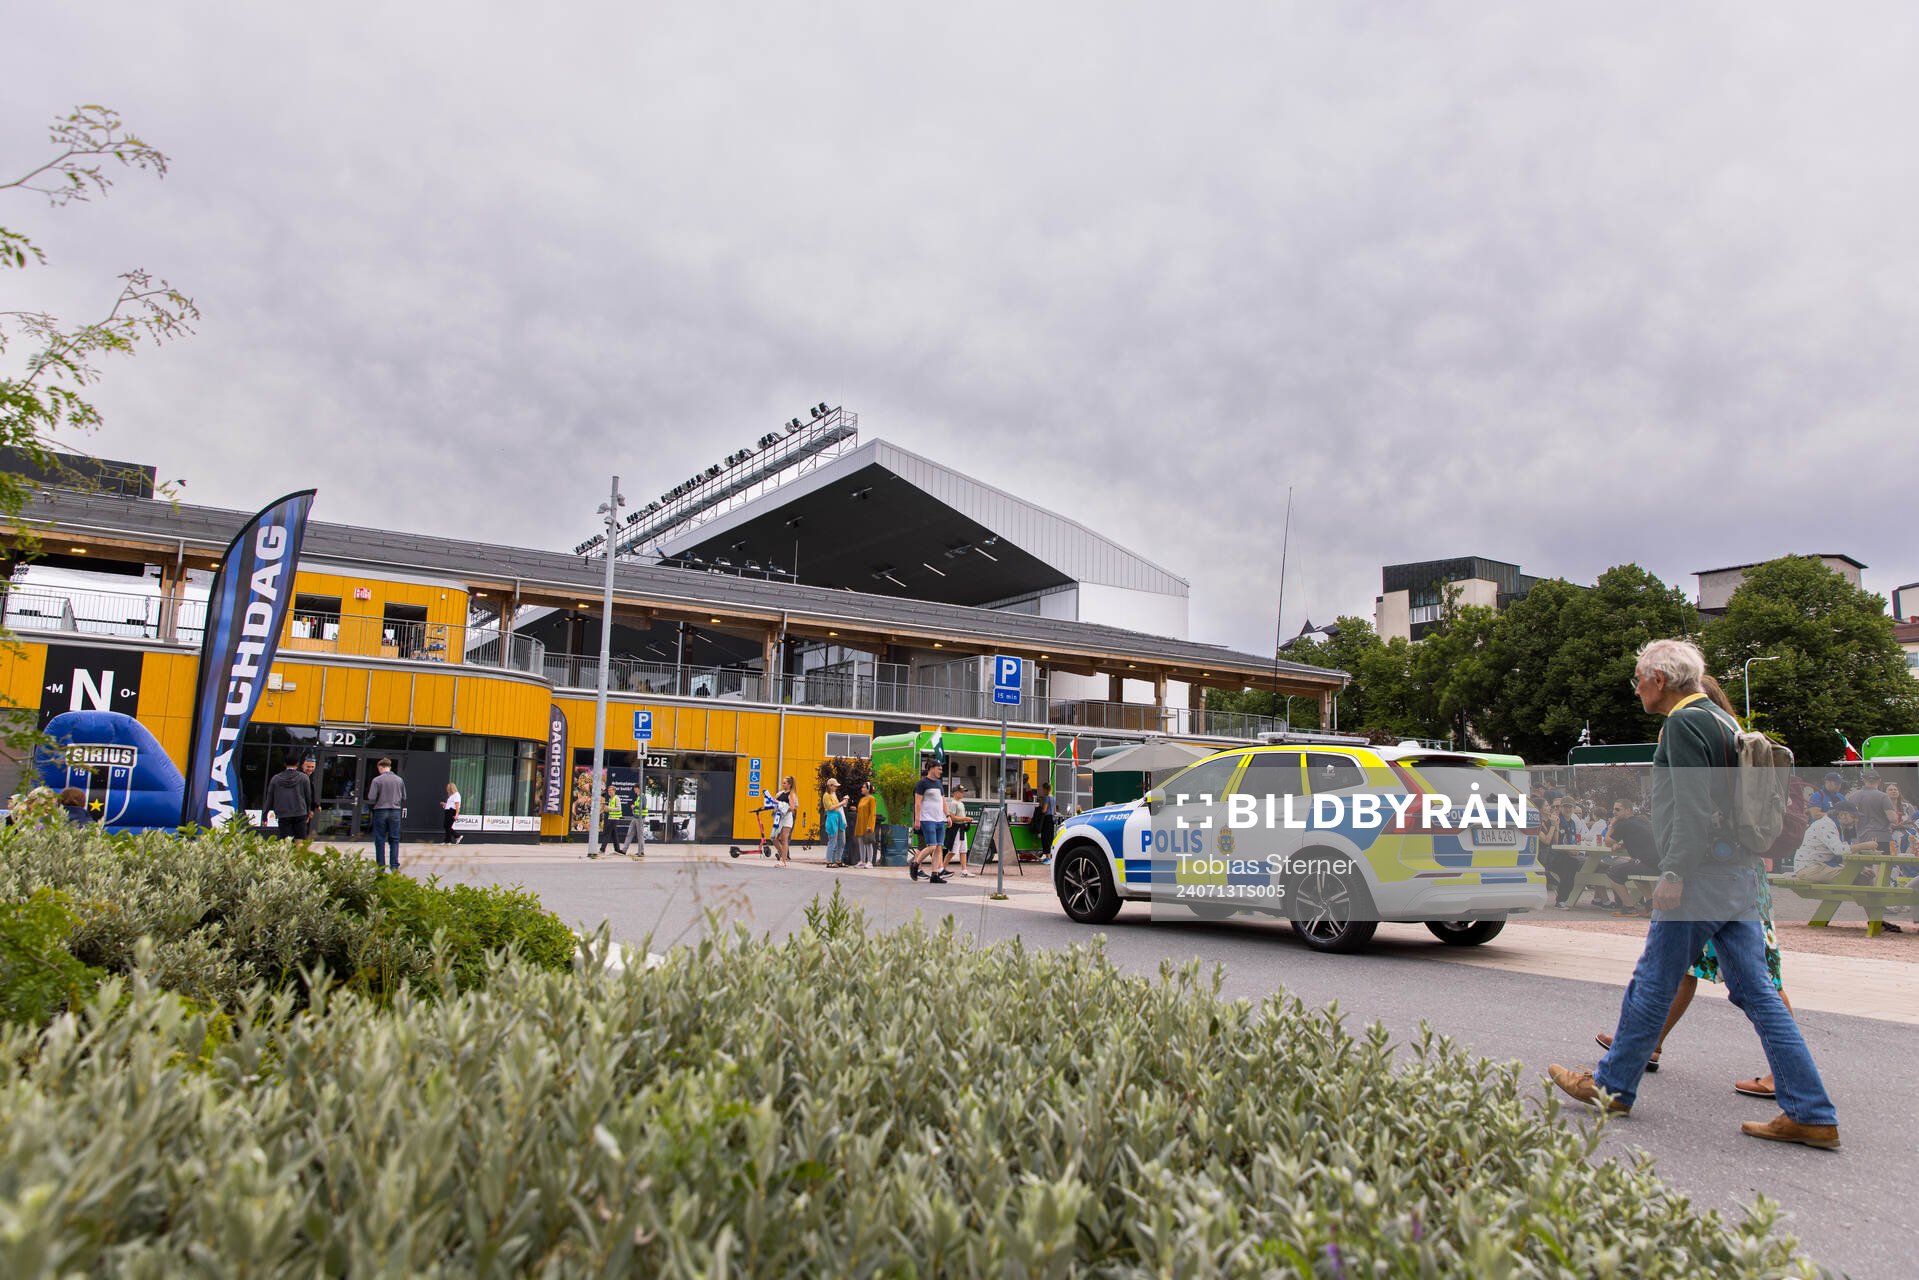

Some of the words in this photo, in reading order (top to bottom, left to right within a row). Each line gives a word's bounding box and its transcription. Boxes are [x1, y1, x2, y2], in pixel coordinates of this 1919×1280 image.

[206, 525, 288, 828] MATCHDAG
[1001, 659, 1017, 684] P
[51, 683, 63, 694] M
[69, 668, 115, 712] N
[638, 713, 649, 728] P
[326, 732, 357, 745] 12D
[72, 748, 132, 764] SIRIUS
[646, 757, 668, 768] 12E
[752, 759, 760, 769] P
[114, 769, 126, 778] 07
[1141, 829, 1203, 854] POLIS
[1481, 831, 1496, 843] AHA
